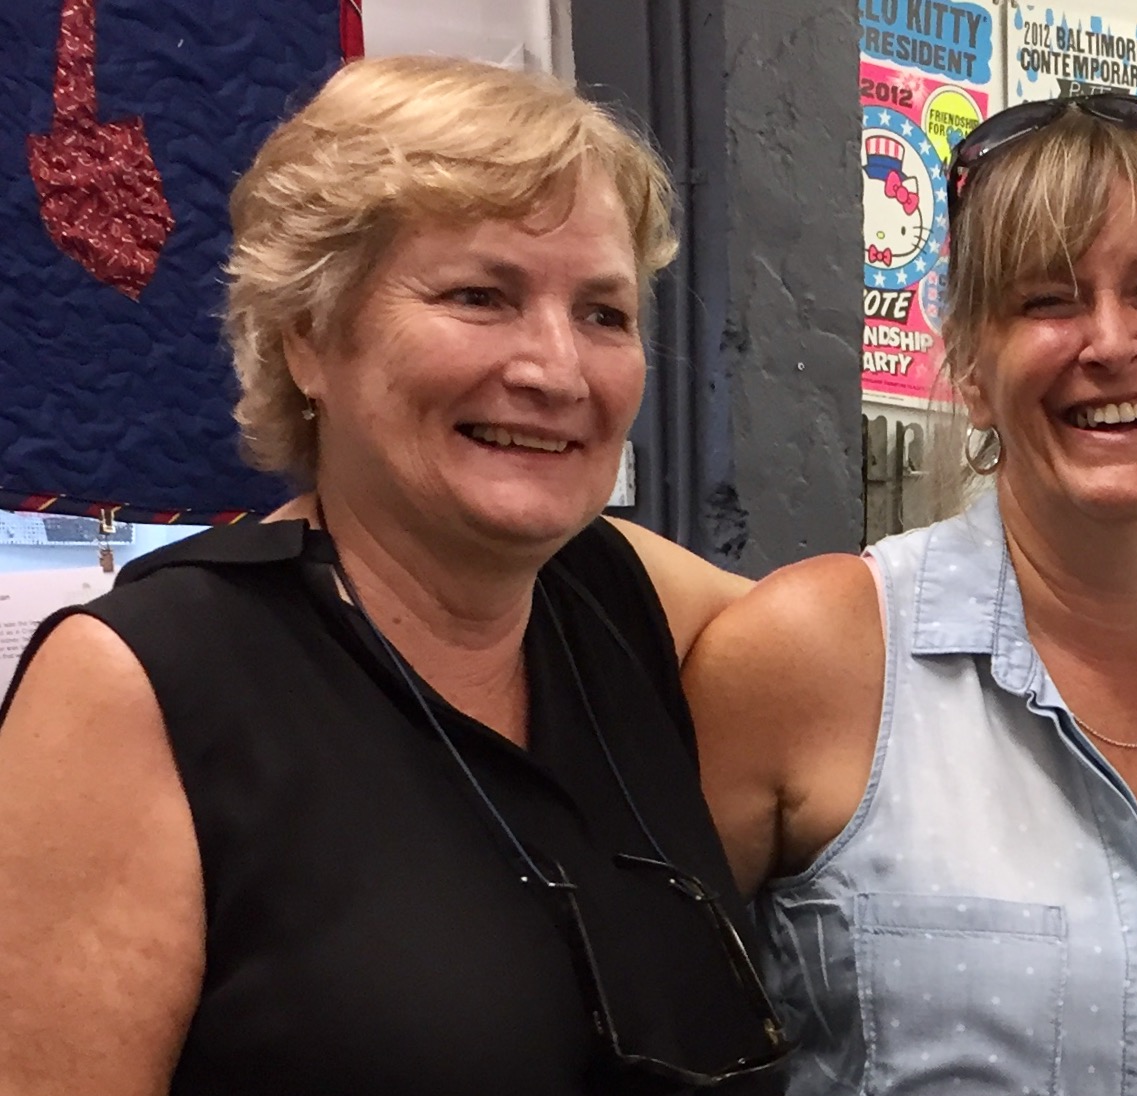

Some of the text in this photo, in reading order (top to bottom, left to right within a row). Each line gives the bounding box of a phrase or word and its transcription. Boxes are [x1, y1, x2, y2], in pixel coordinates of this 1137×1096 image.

[1024, 21, 1050, 48] 2012
[860, 78, 914, 108] 2012
[928, 121, 946, 137] FOR
[863, 289, 913, 319] OTE
